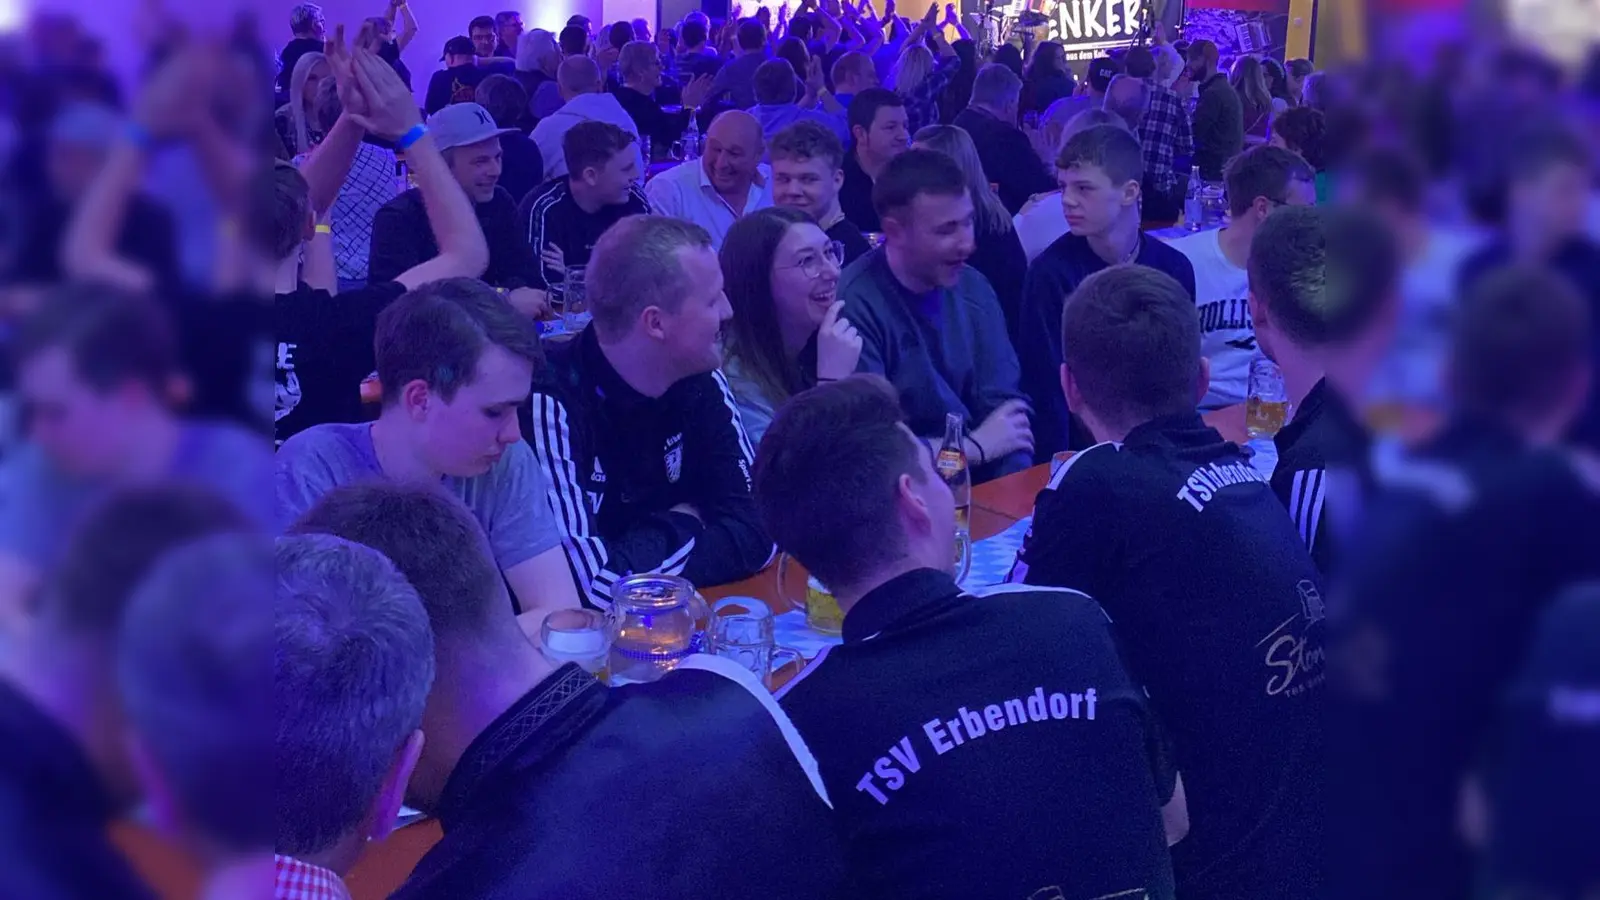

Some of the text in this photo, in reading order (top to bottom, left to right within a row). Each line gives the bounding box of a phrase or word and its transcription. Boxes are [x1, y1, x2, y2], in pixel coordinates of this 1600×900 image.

[1079, 50, 1093, 60] dem
[855, 686, 1097, 805] TSV Erbendorf
